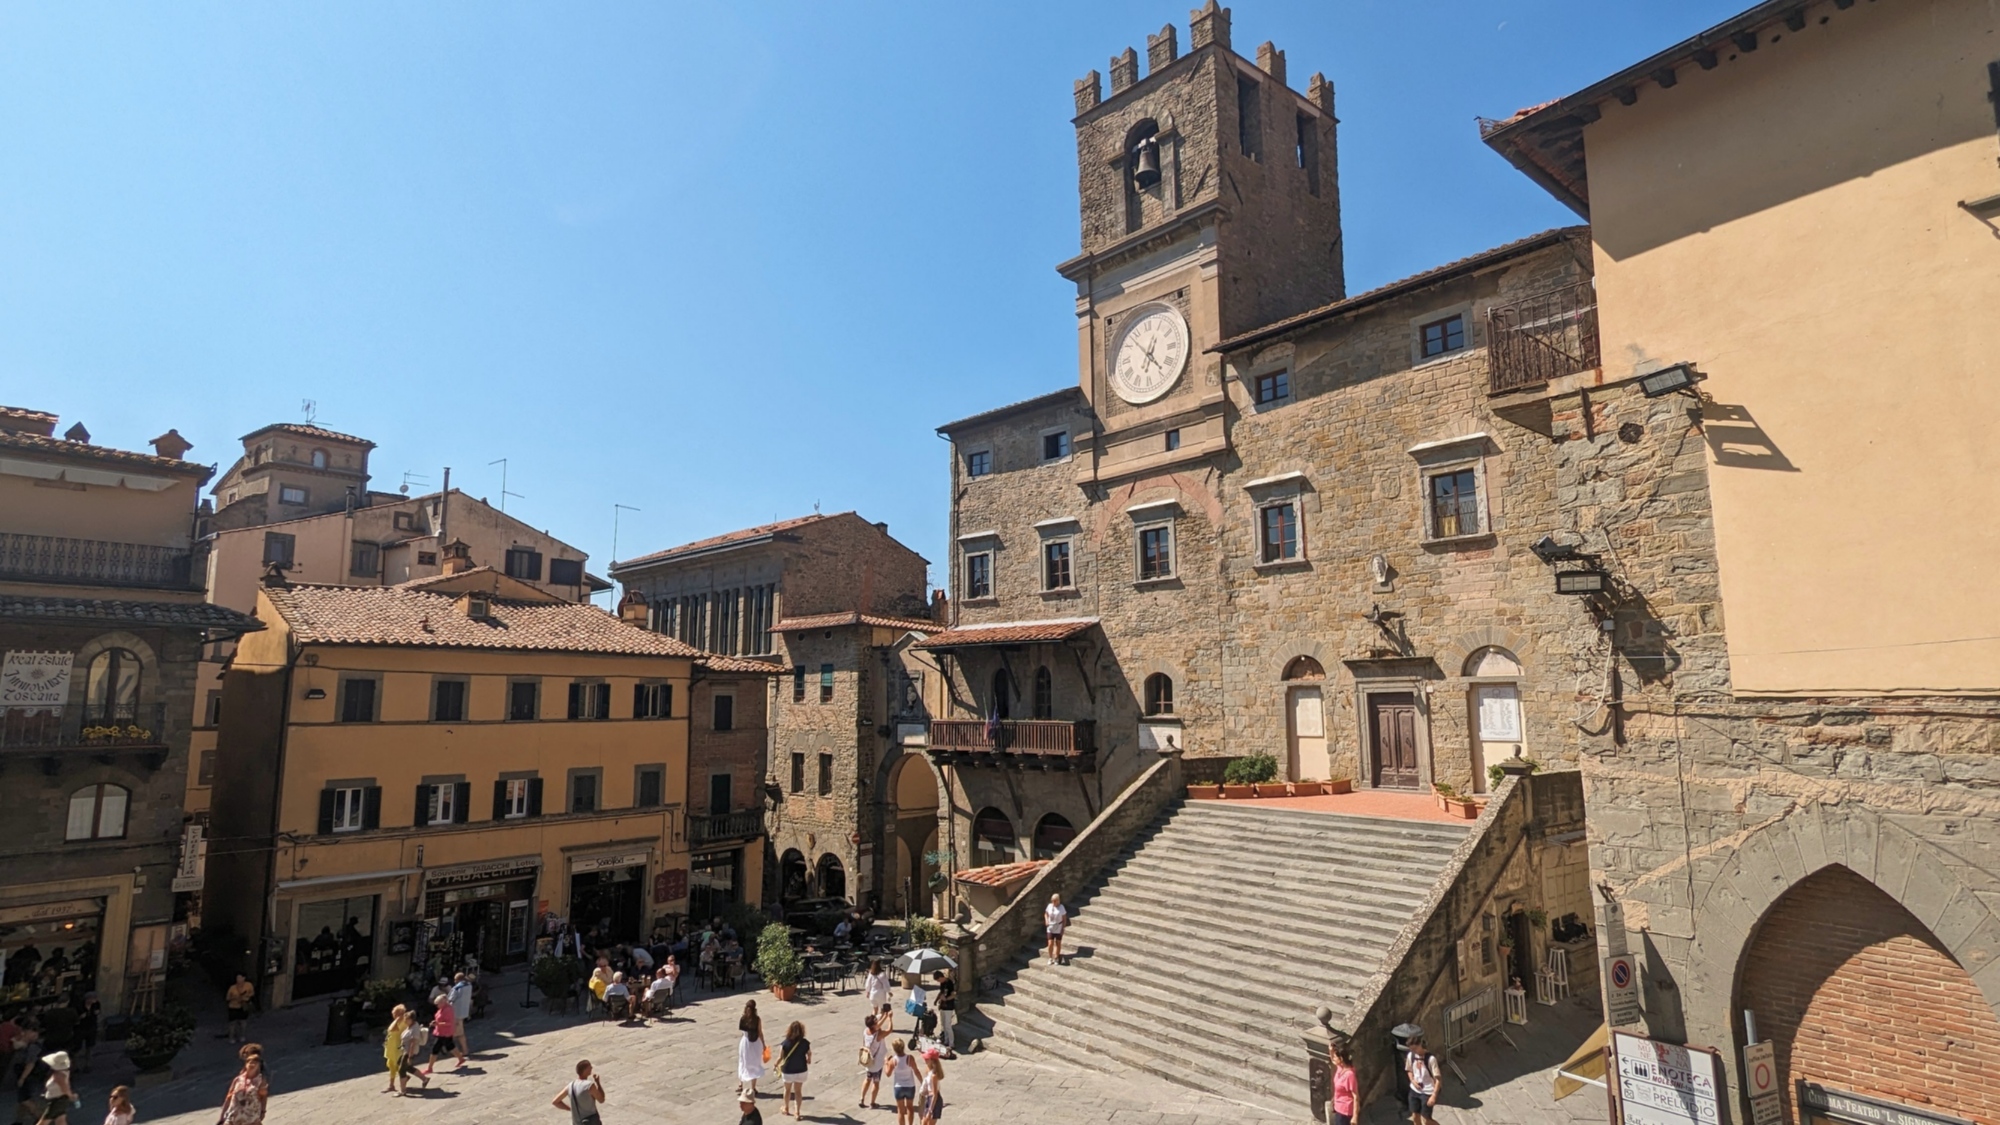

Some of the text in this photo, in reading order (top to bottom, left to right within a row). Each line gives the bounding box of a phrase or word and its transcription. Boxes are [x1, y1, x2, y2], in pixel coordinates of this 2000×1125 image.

[8, 655, 72, 667] Real Estate
[4, 689, 60, 702] Toscana
[431, 868, 467, 879] Souvenir
[473, 863, 510, 874] TABACCHI
[516, 859, 536, 867] Lotto
[1651, 1063, 1713, 1090] ENOTECA
[1653, 1093, 1716, 1118] PRELUDIO
